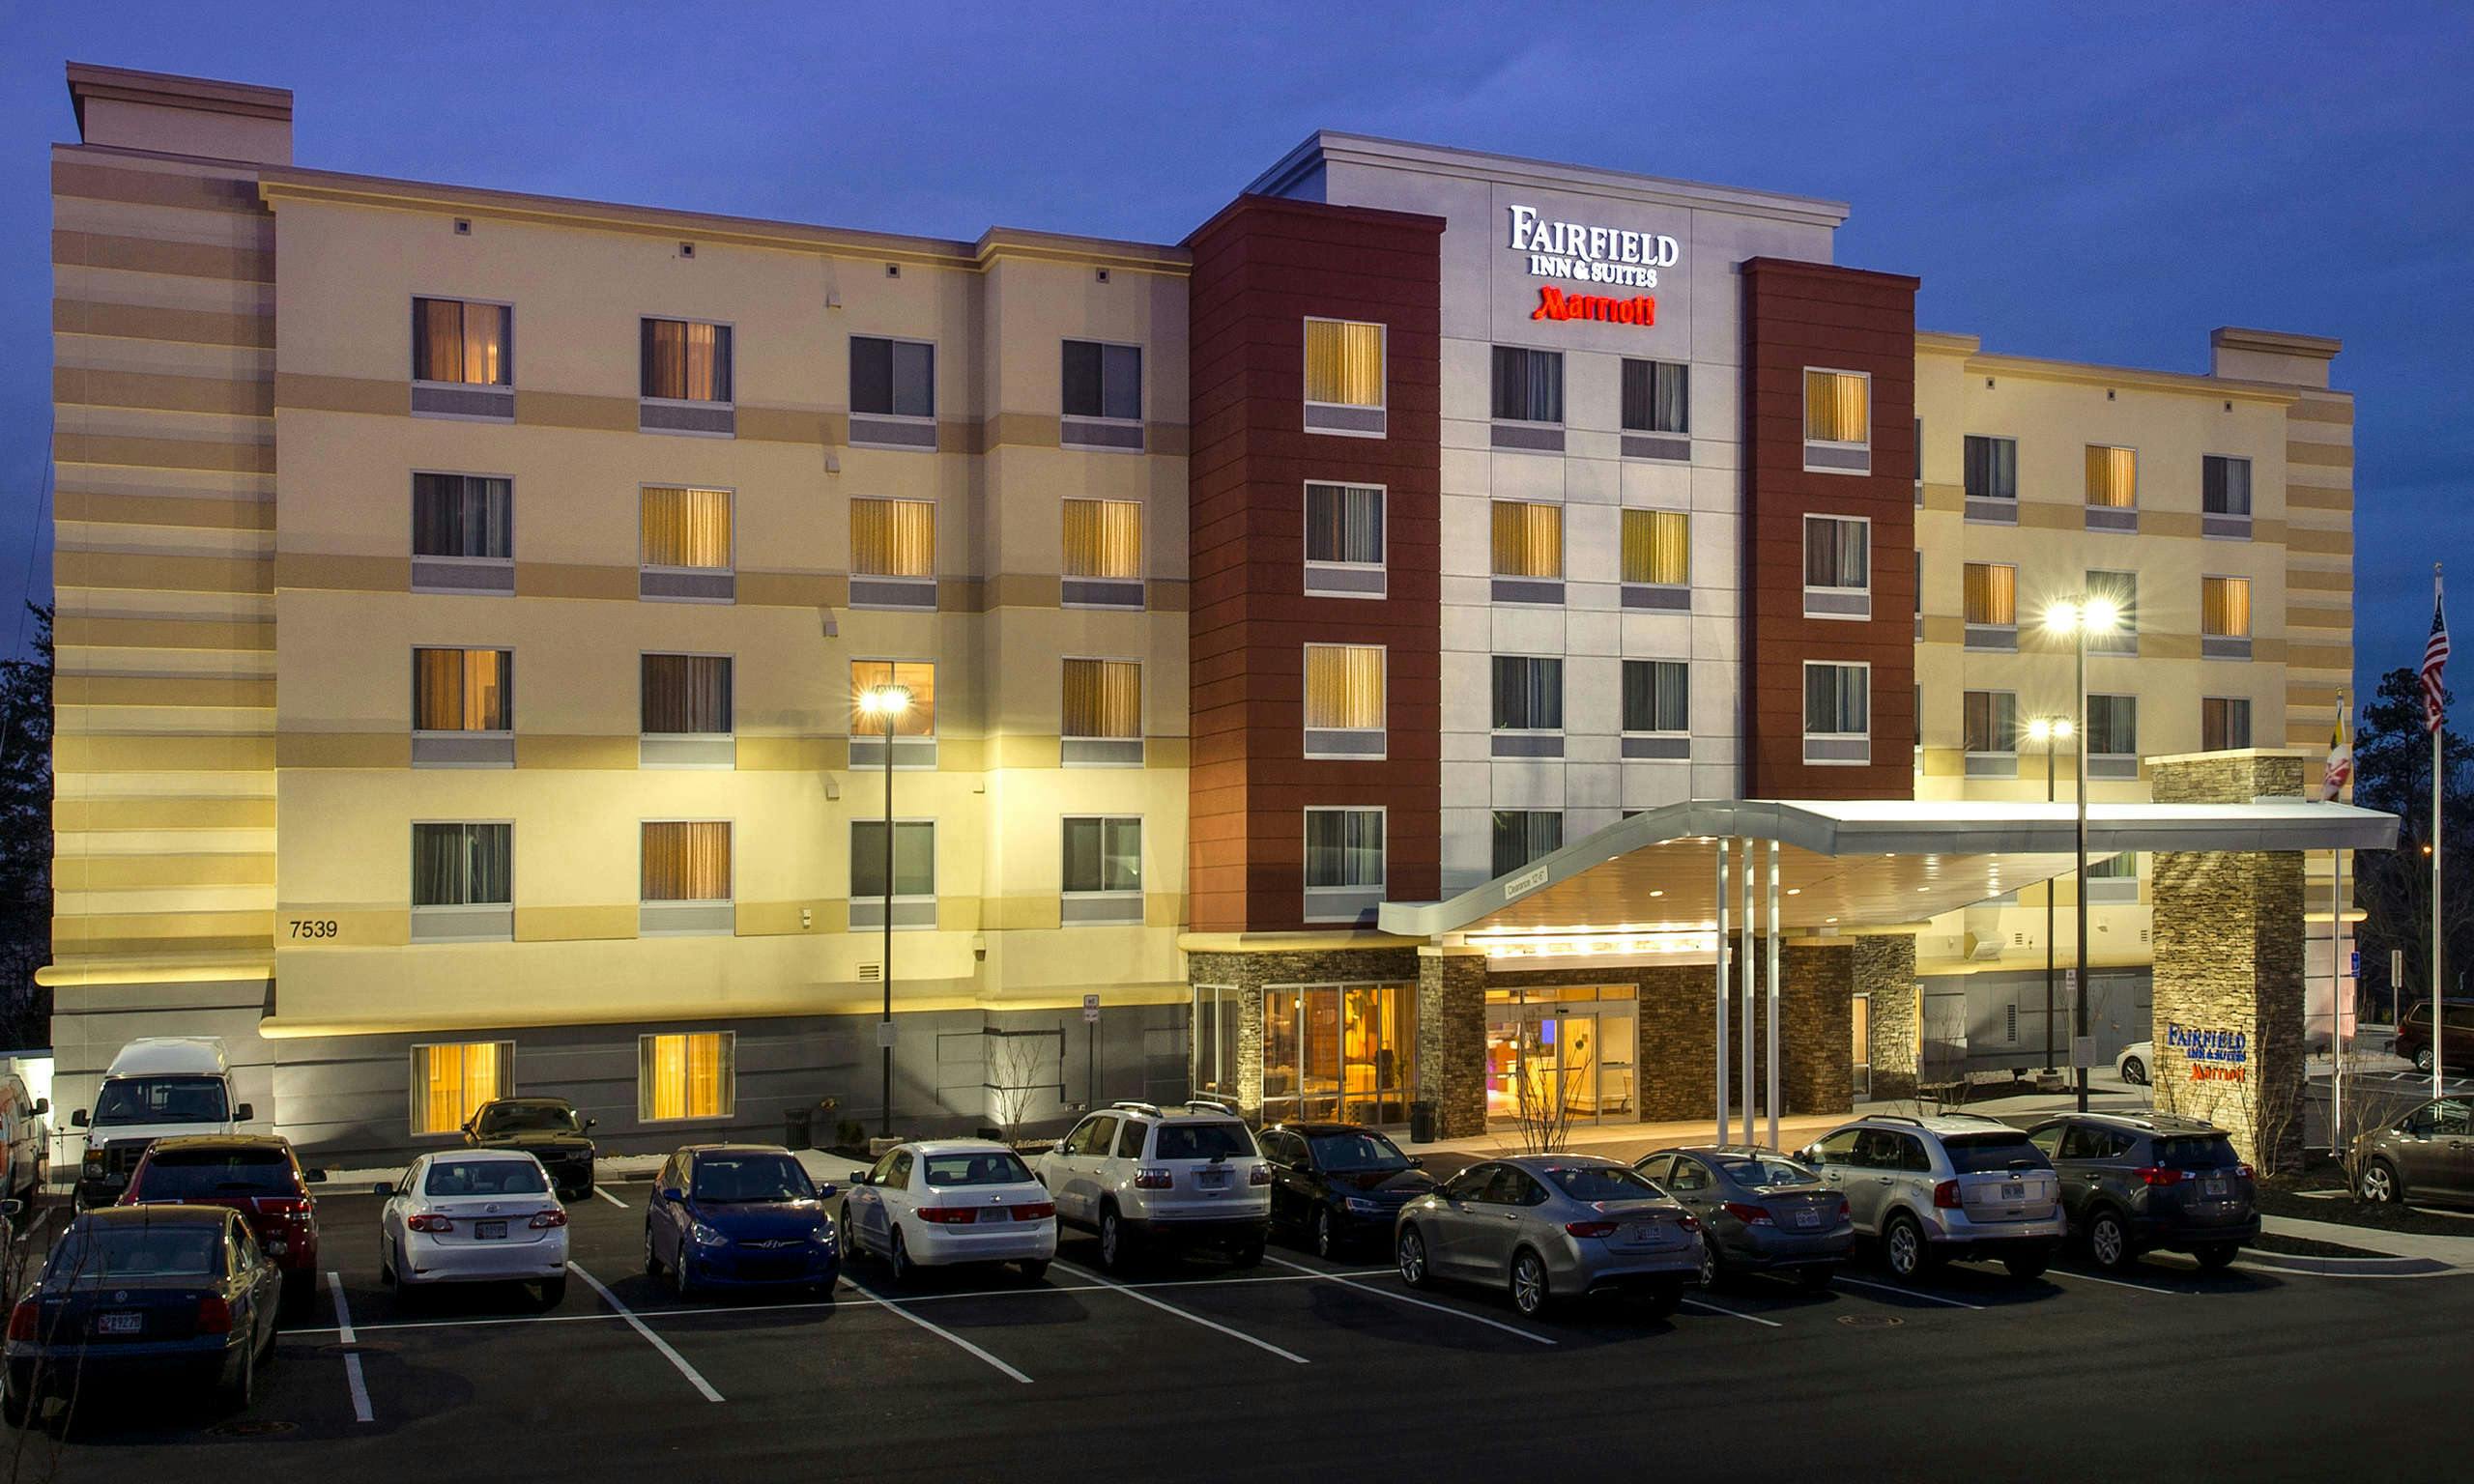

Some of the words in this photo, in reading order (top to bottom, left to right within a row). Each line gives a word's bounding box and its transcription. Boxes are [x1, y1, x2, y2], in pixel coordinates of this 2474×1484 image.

[1510, 204, 1680, 268] FAIRFIELD
[1531, 254, 1572, 279] INN
[1572, 261, 1591, 281] &
[1591, 263, 1658, 289] SUITES
[1532, 285, 1655, 326] Marriott
[290, 921, 337, 938] 7539
[2168, 1023, 2246, 1050] FAIRFIELD
[2189, 1063, 2246, 1083] Marriott
